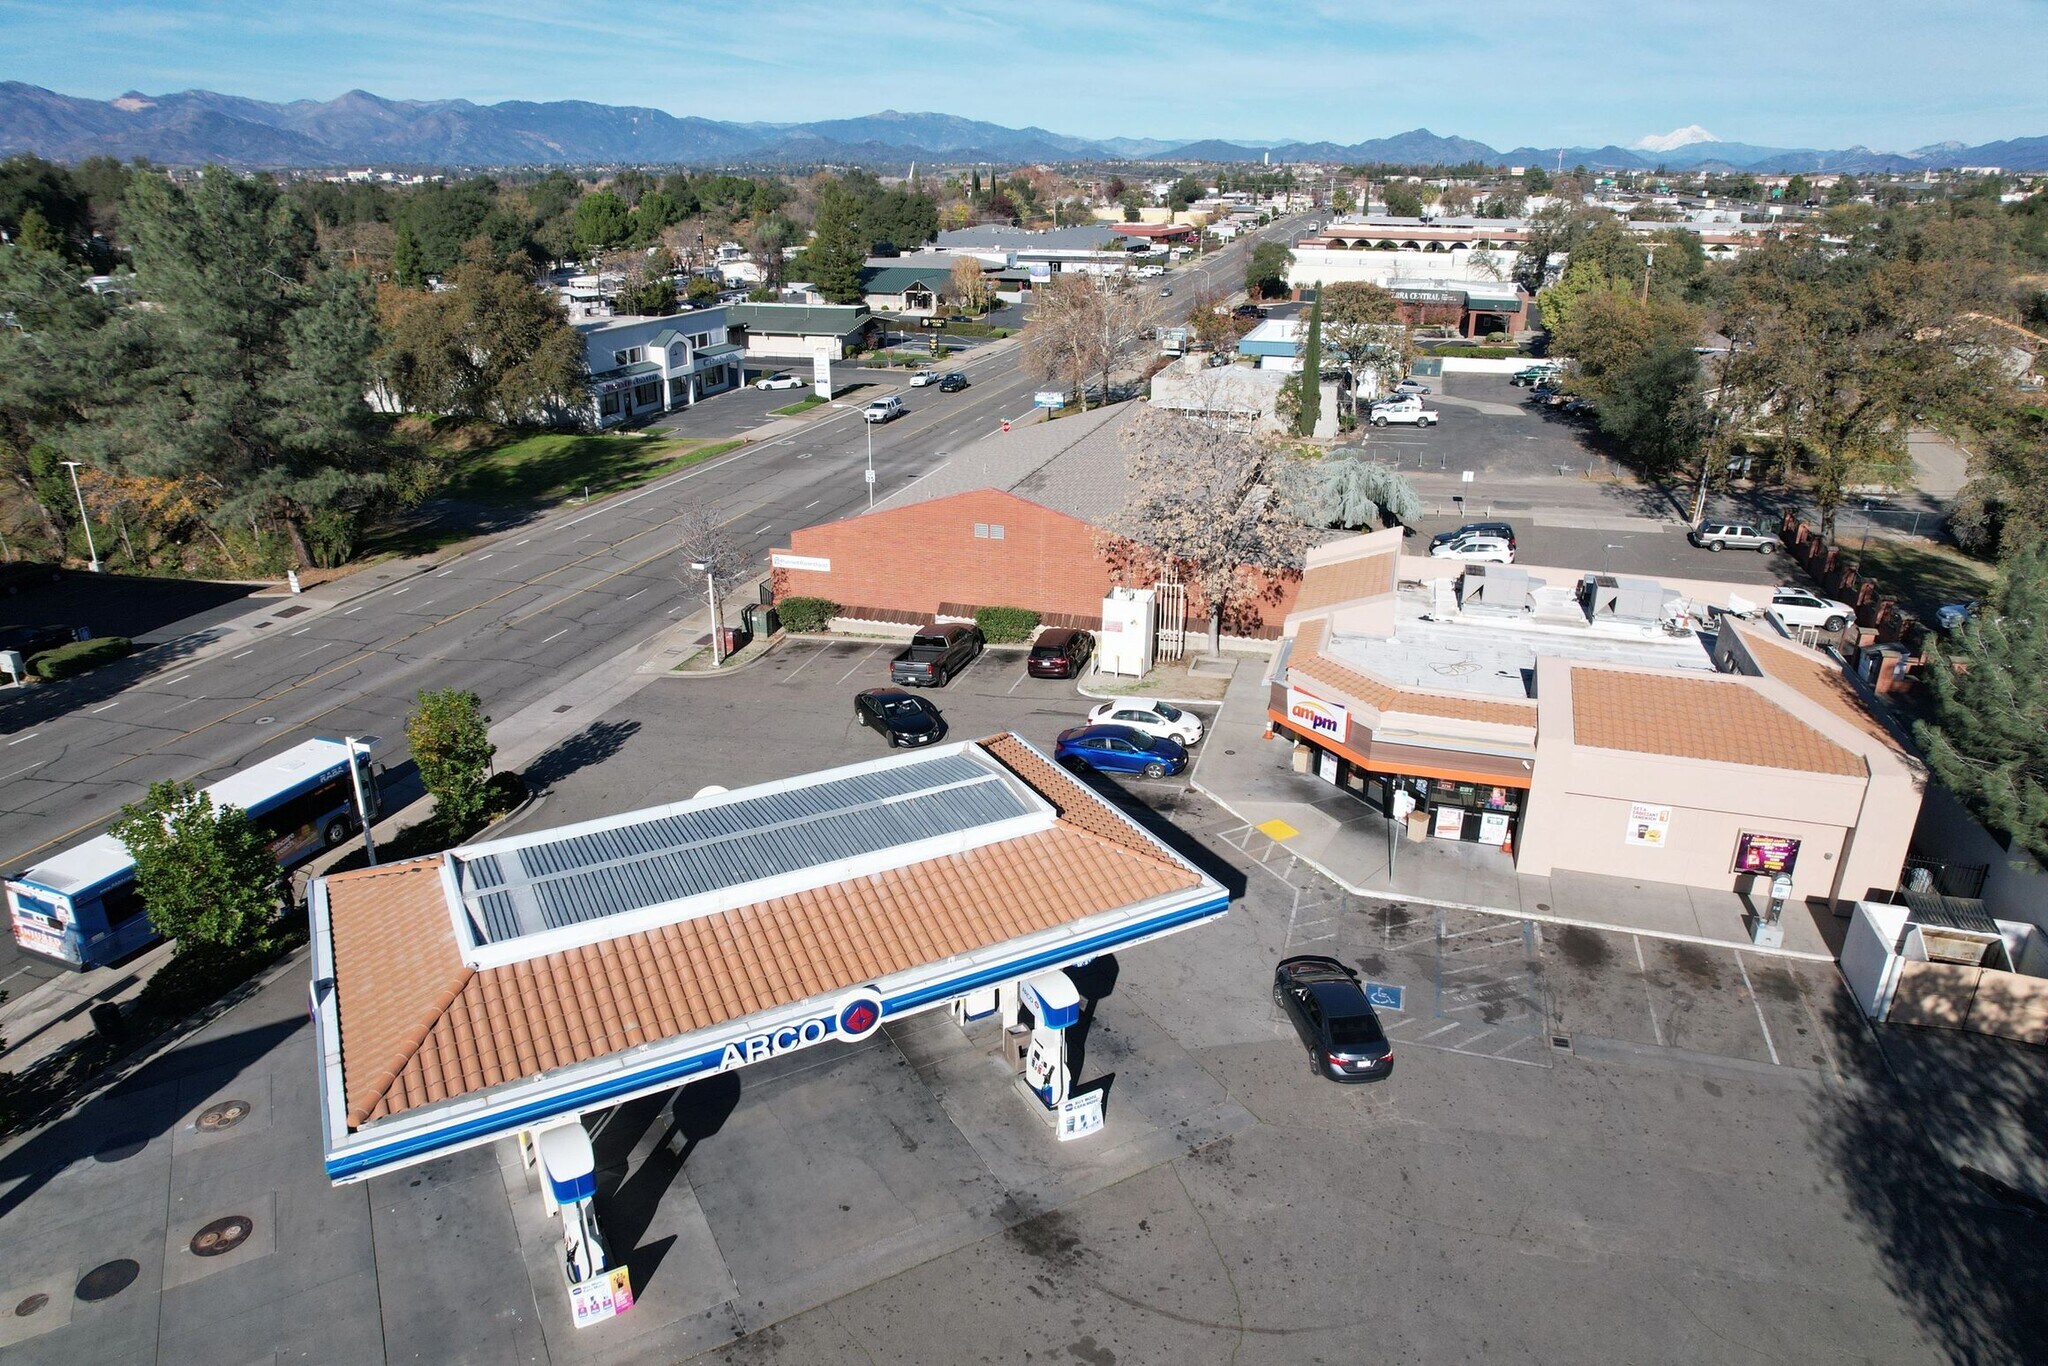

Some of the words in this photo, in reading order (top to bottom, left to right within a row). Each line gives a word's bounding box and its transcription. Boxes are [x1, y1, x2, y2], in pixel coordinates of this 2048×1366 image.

[1409, 292, 1440, 300] CENTRAL
[1292, 705, 1337, 732] ampm
[320, 766, 344, 782] RABA
[718, 1019, 826, 1071] ARCO
